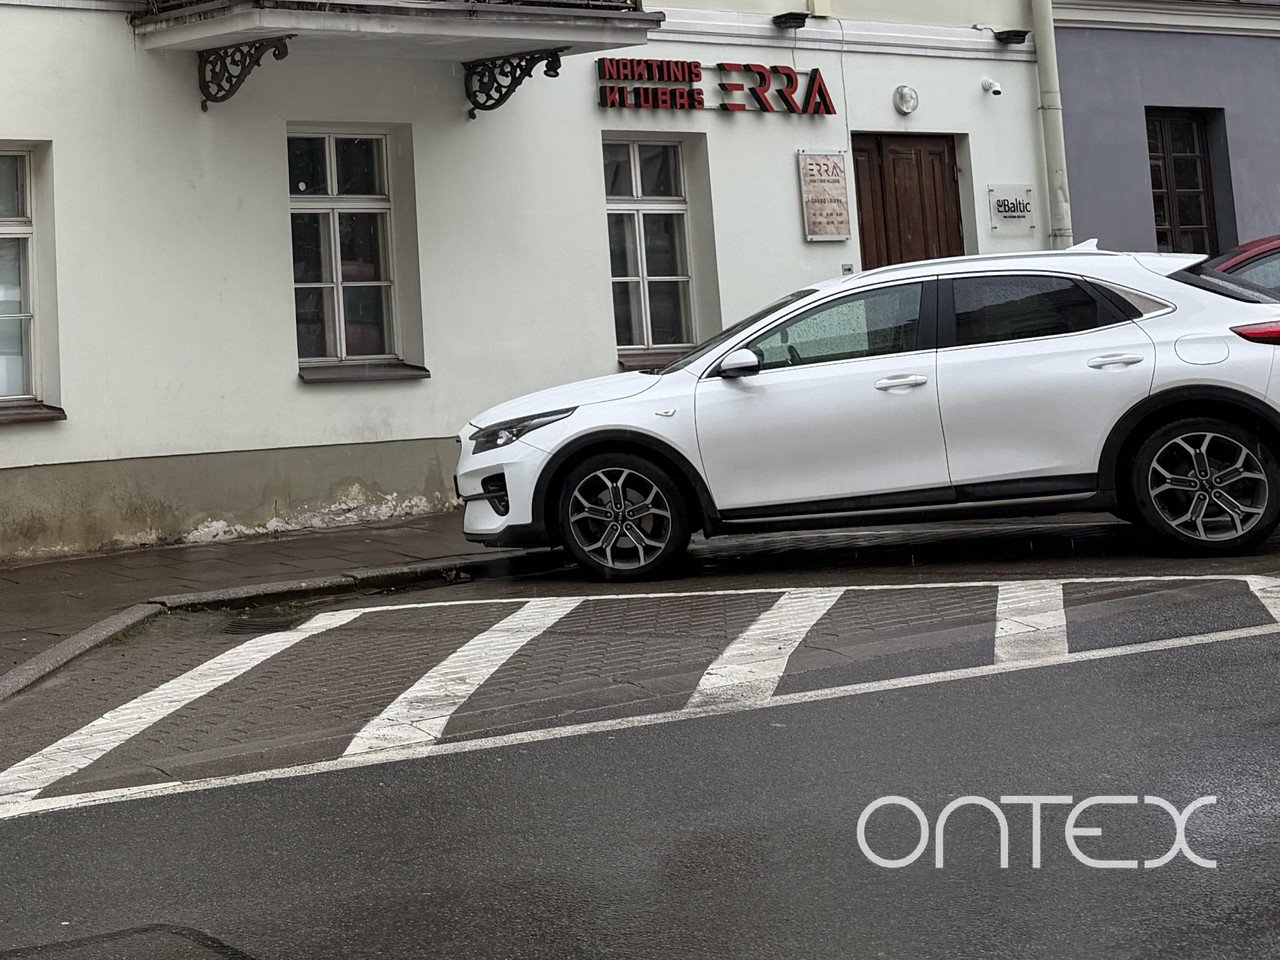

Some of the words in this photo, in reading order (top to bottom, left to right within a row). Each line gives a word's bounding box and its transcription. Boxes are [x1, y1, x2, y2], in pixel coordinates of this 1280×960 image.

[597, 58, 703, 83] NAKTINIS
[599, 86, 705, 110] KLUBAS
[716, 62, 837, 115] ERRA
[808, 163, 840, 177] ERRA
